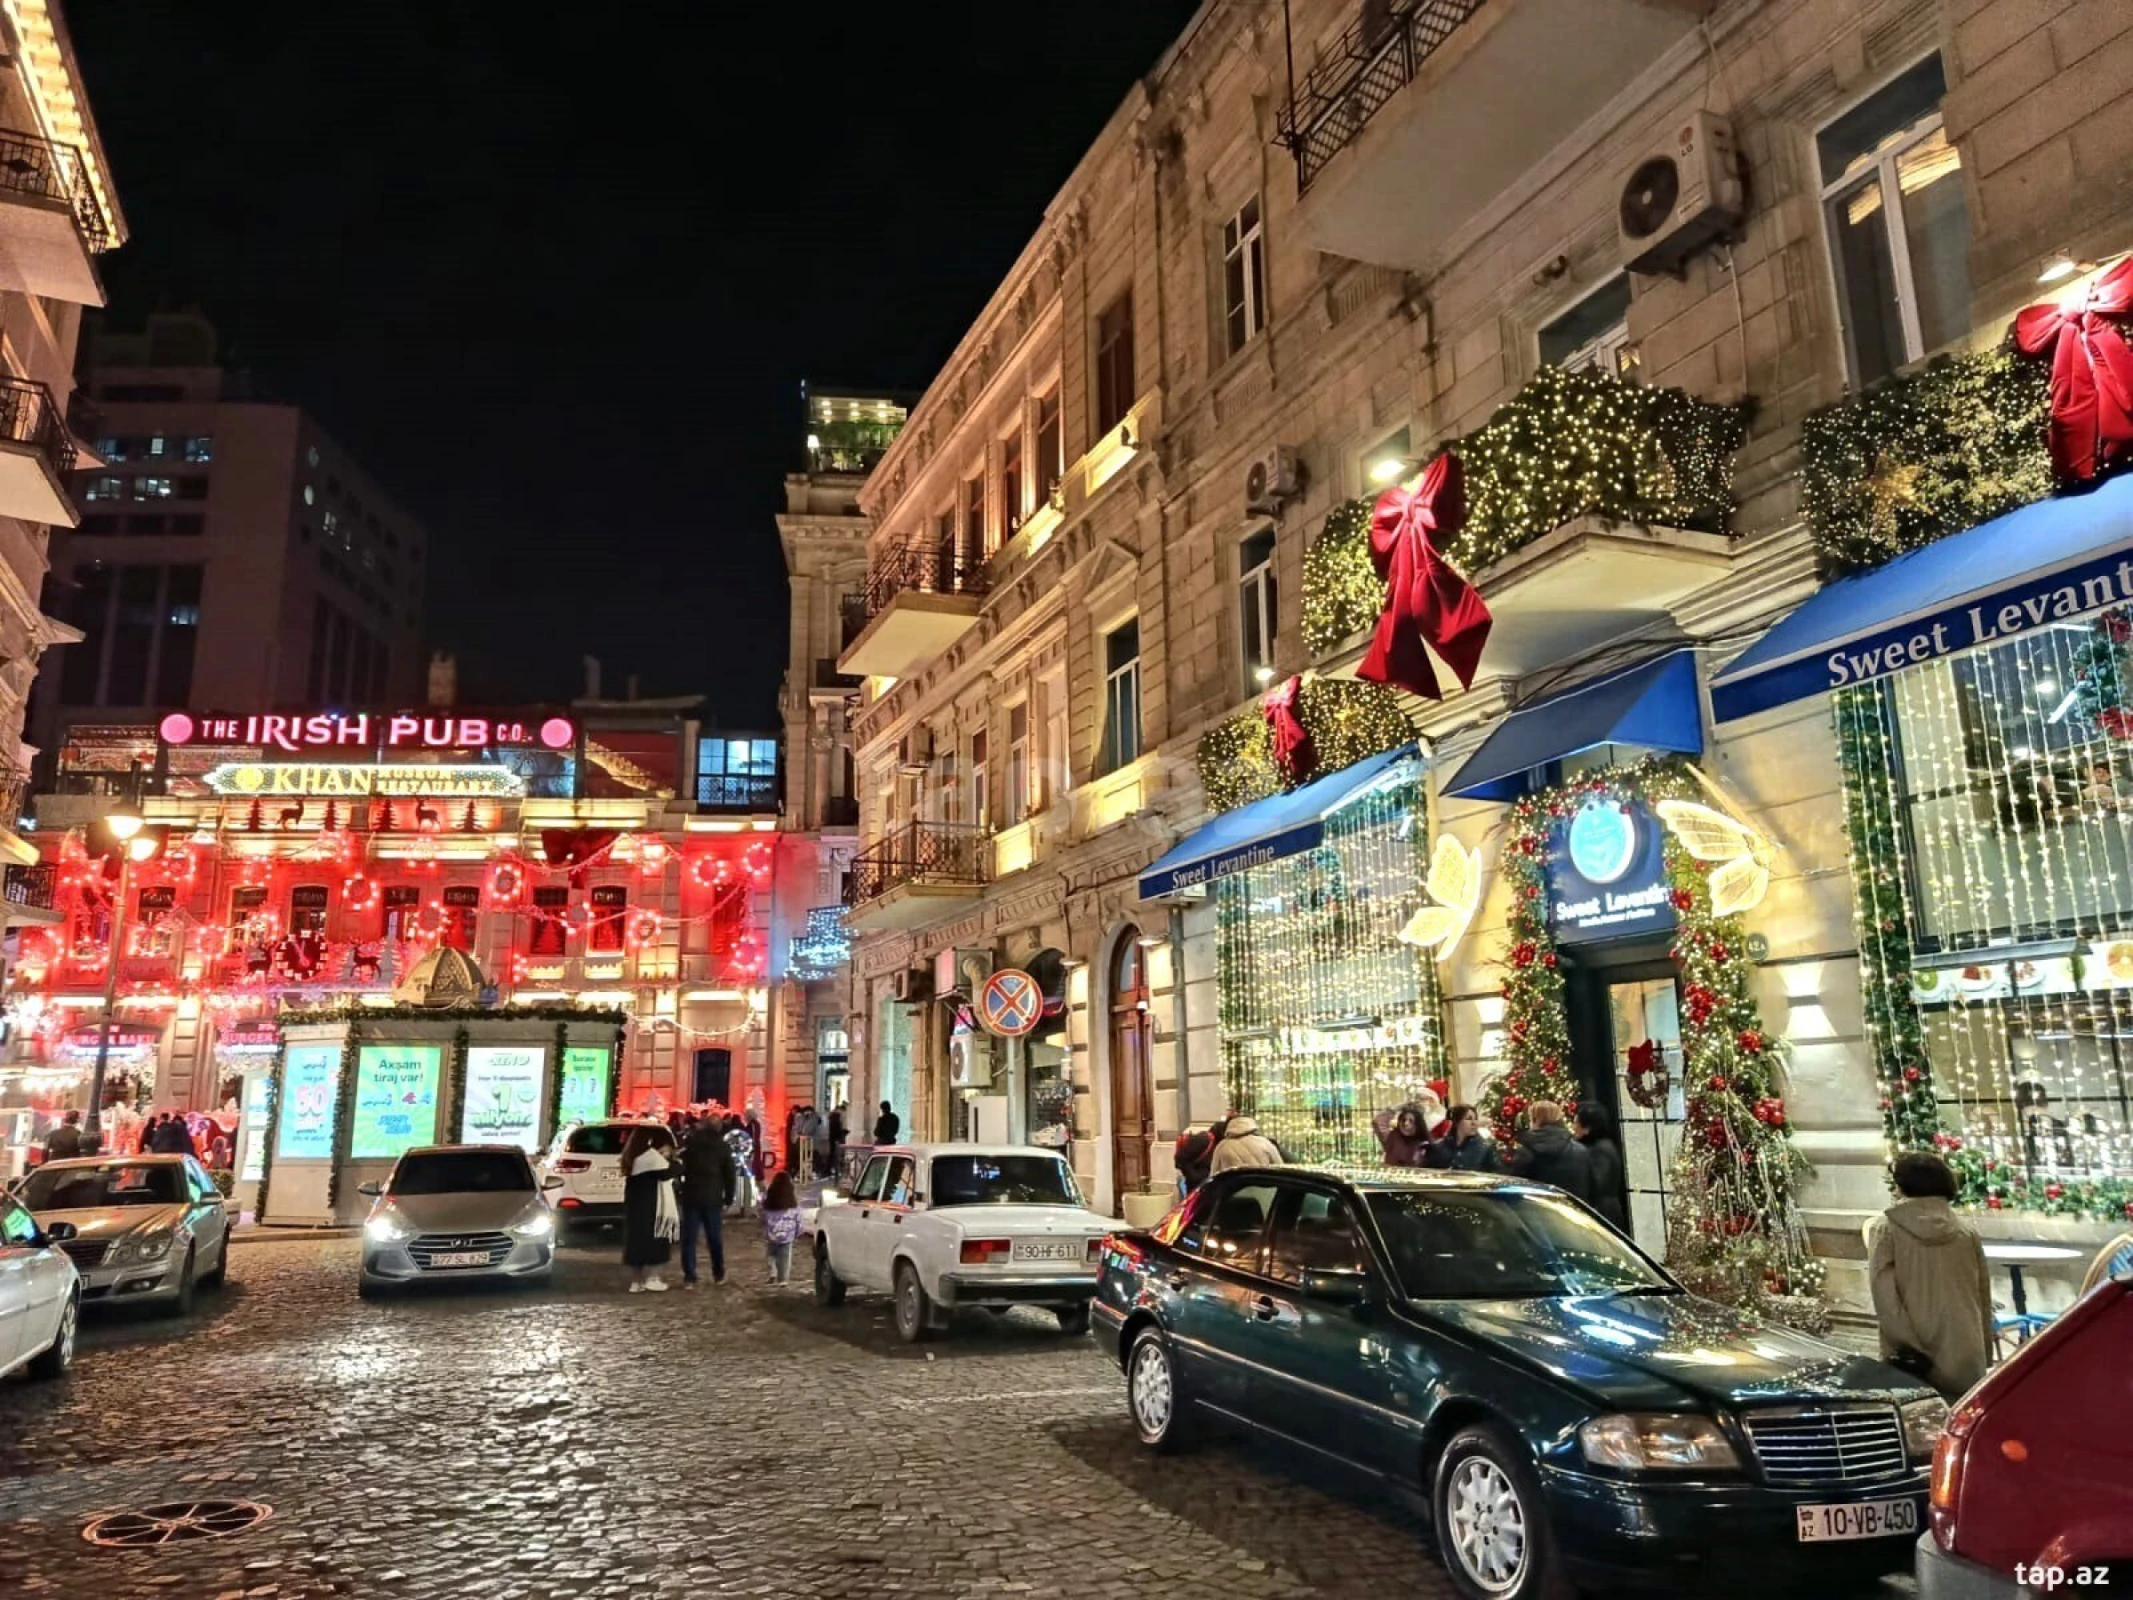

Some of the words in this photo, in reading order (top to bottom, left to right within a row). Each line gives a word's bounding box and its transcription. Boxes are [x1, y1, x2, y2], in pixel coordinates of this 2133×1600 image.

[1828, 623, 1951, 687] Sweet
[202, 720, 239, 738] THE
[246, 715, 368, 750] IRISH
[389, 718, 489, 745] PUB
[273, 767, 372, 793] KHAN
[1172, 864, 1206, 889] Sweet
[1211, 845, 1275, 878] Levantine
[1824, 1502, 1915, 1537] 10-VB-450
